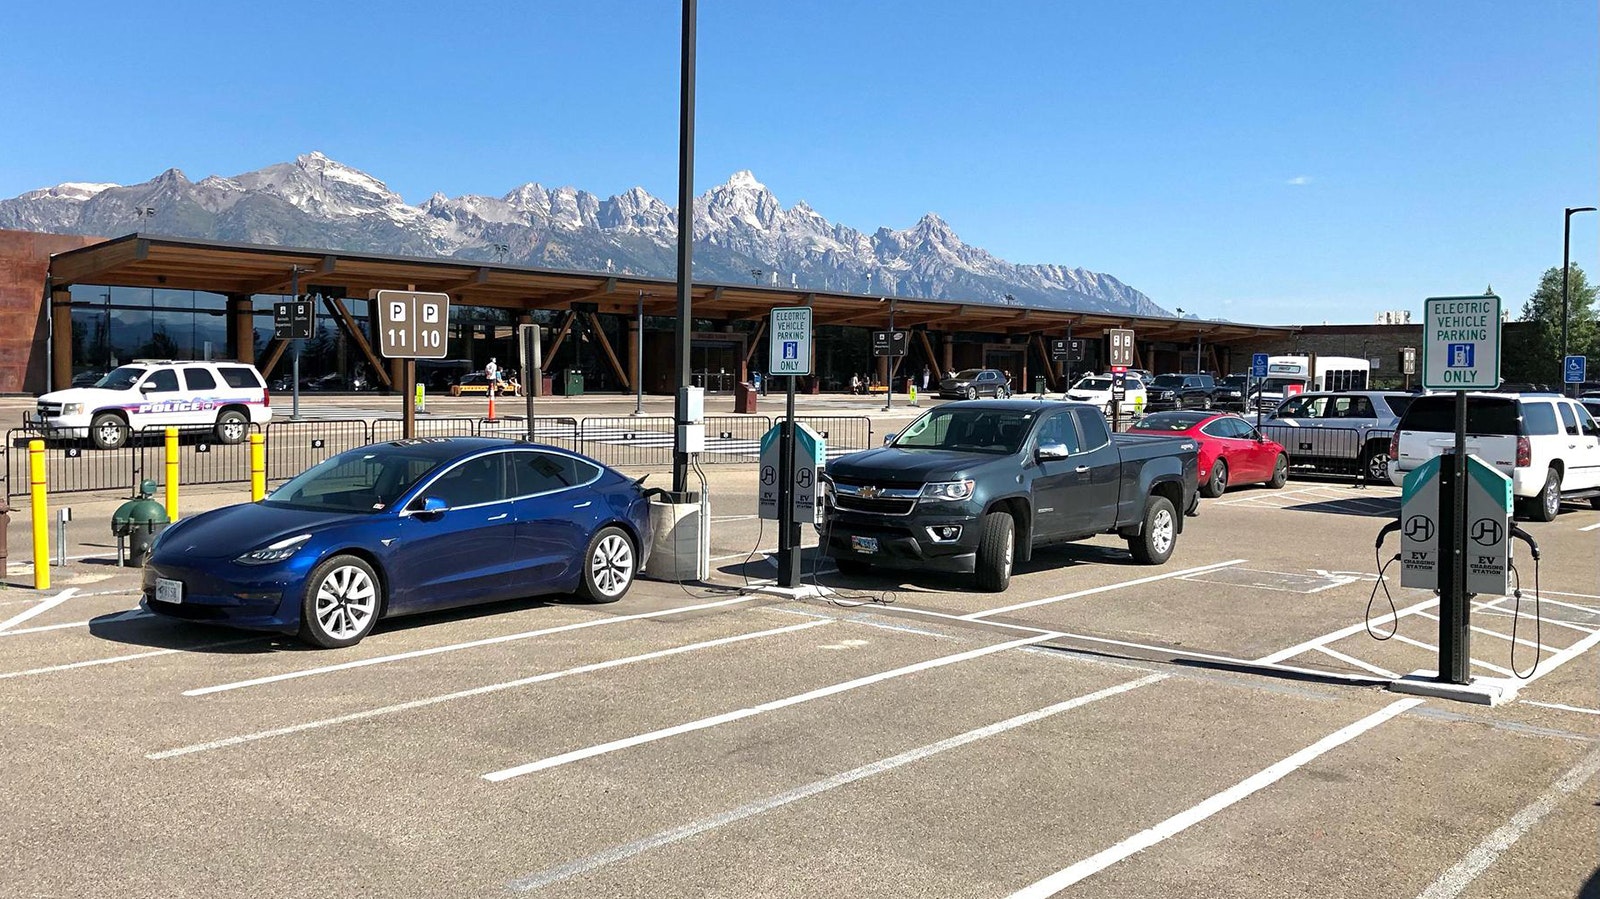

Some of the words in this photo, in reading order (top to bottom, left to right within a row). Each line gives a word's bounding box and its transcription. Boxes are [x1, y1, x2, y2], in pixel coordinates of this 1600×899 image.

[1434, 302, 1490, 314] ELECTRIC
[776, 312, 806, 321] ELECTRIC
[1437, 315, 1487, 327] VEHICLE
[777, 321, 804, 330] VEHICLE
[388, 328, 406, 347] 11
[421, 329, 440, 348] 10
[777, 331, 804, 340] PARKING
[1437, 329, 1487, 341] PARKING
[1114, 349, 1119, 360] 9
[1125, 350, 1129, 360] 8
[780, 360, 799, 370] ONLY
[1443, 370, 1478, 383] ONLY
[139, 402, 200, 414] POLICE
[1411, 552, 1427, 560] EV
[1478, 556, 1495, 564] EV
[1470, 563, 1504, 571] CHARGING
